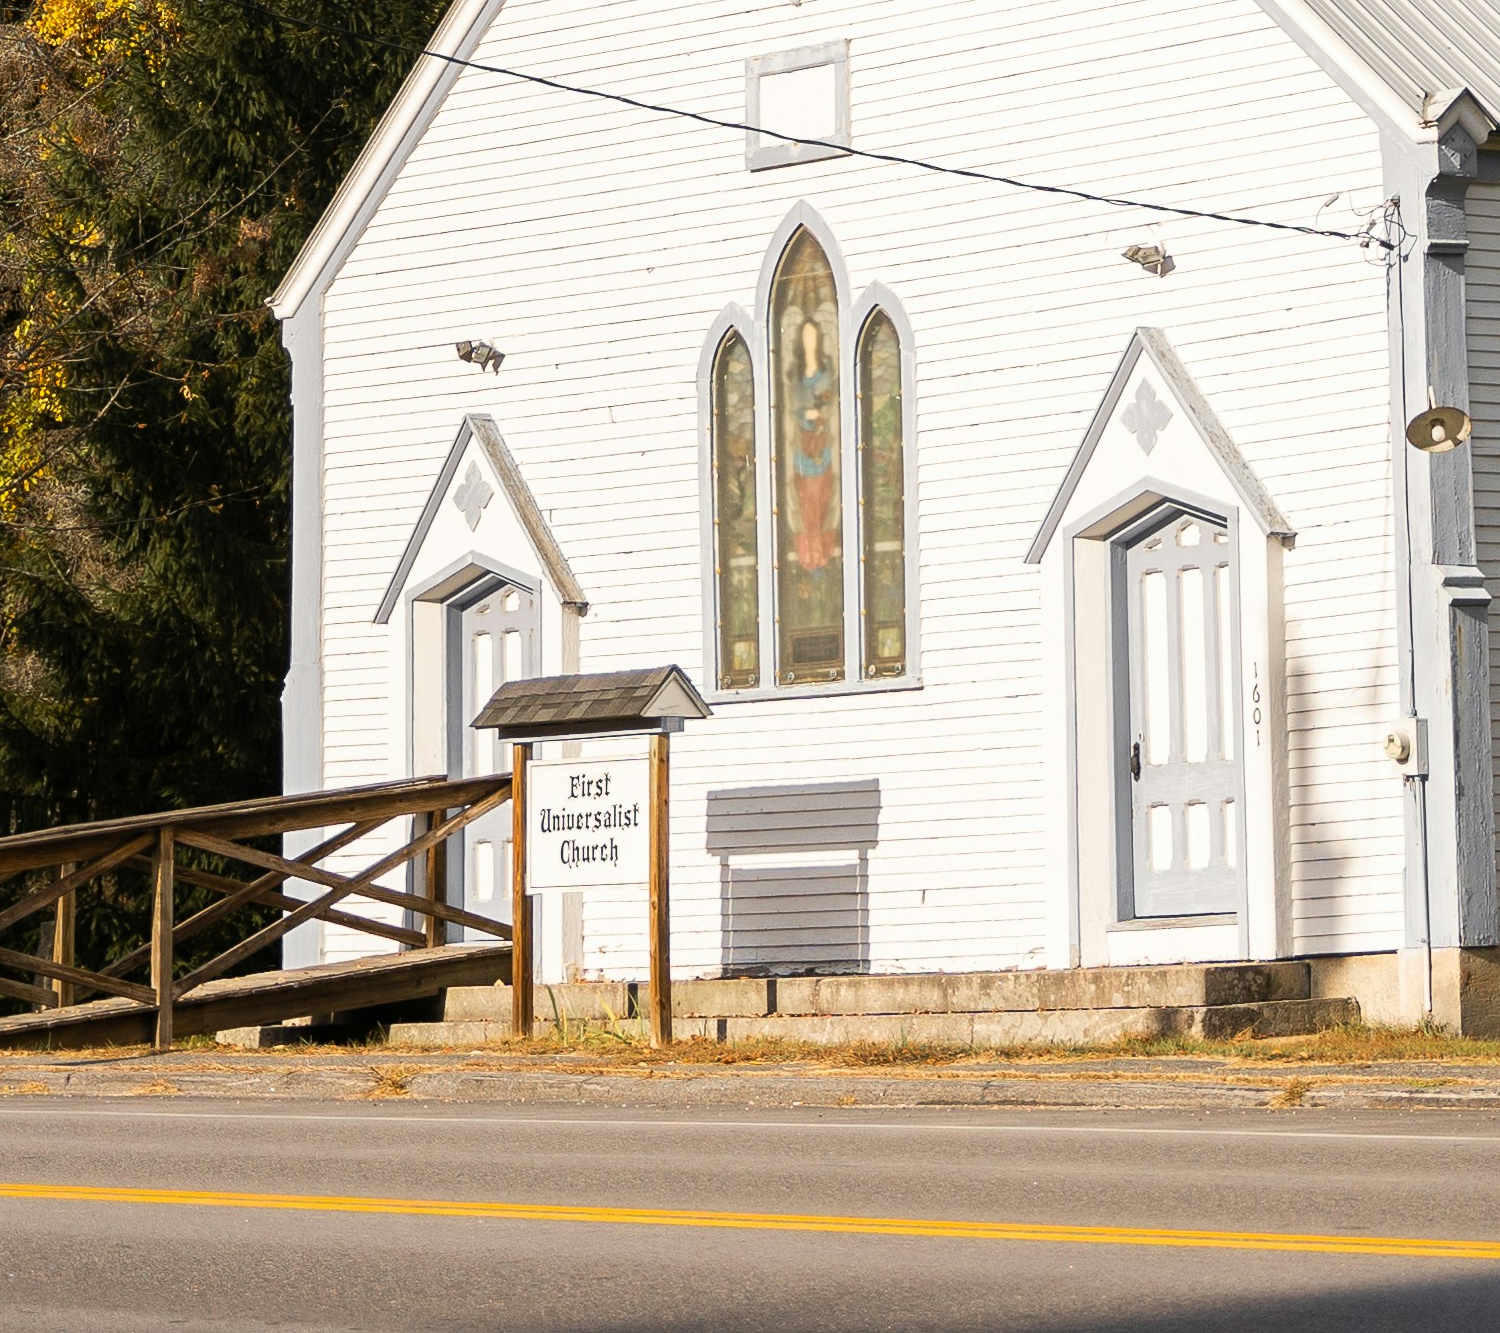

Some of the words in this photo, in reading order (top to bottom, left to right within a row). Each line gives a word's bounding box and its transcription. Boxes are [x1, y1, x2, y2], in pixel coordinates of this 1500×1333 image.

[1252, 661, 1261, 748] 1601
[568, 772, 611, 800] First
[540, 802, 640, 833] Universalist
[560, 837, 618, 869] Church
